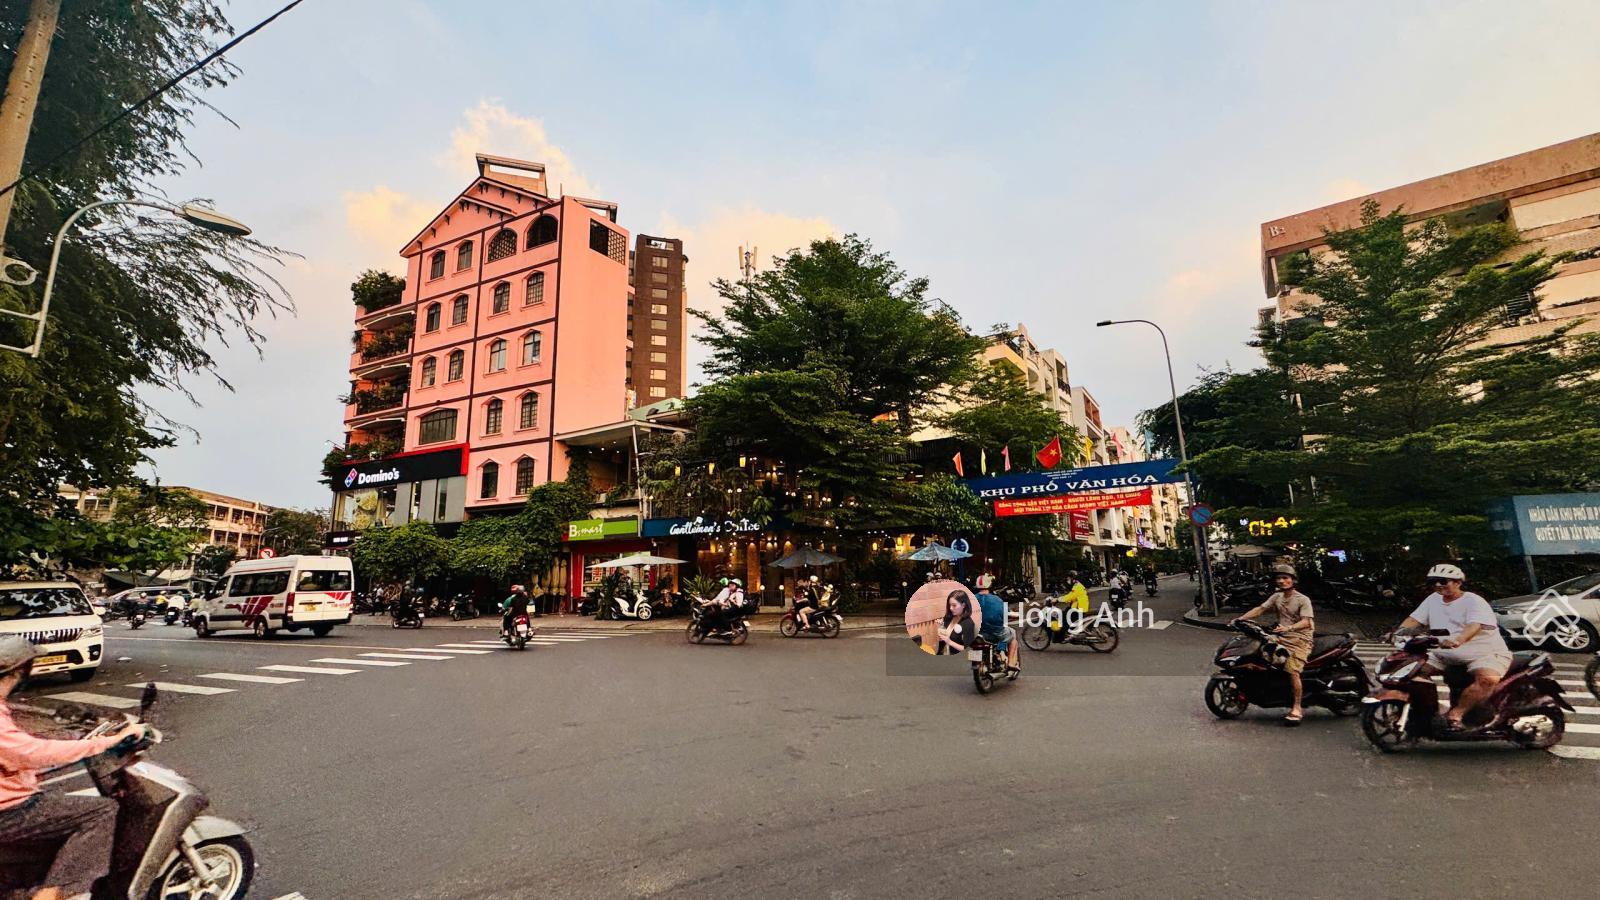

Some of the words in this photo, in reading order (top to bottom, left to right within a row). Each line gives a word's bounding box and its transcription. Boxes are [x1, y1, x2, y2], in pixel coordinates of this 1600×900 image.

[358, 467, 400, 485] Domino's
[980, 487, 1015, 497] KHU
[1021, 480, 1058, 494] PHỐ
[1066, 478, 1107, 490] VĂN
[1109, 474, 1158, 486] HÓA
